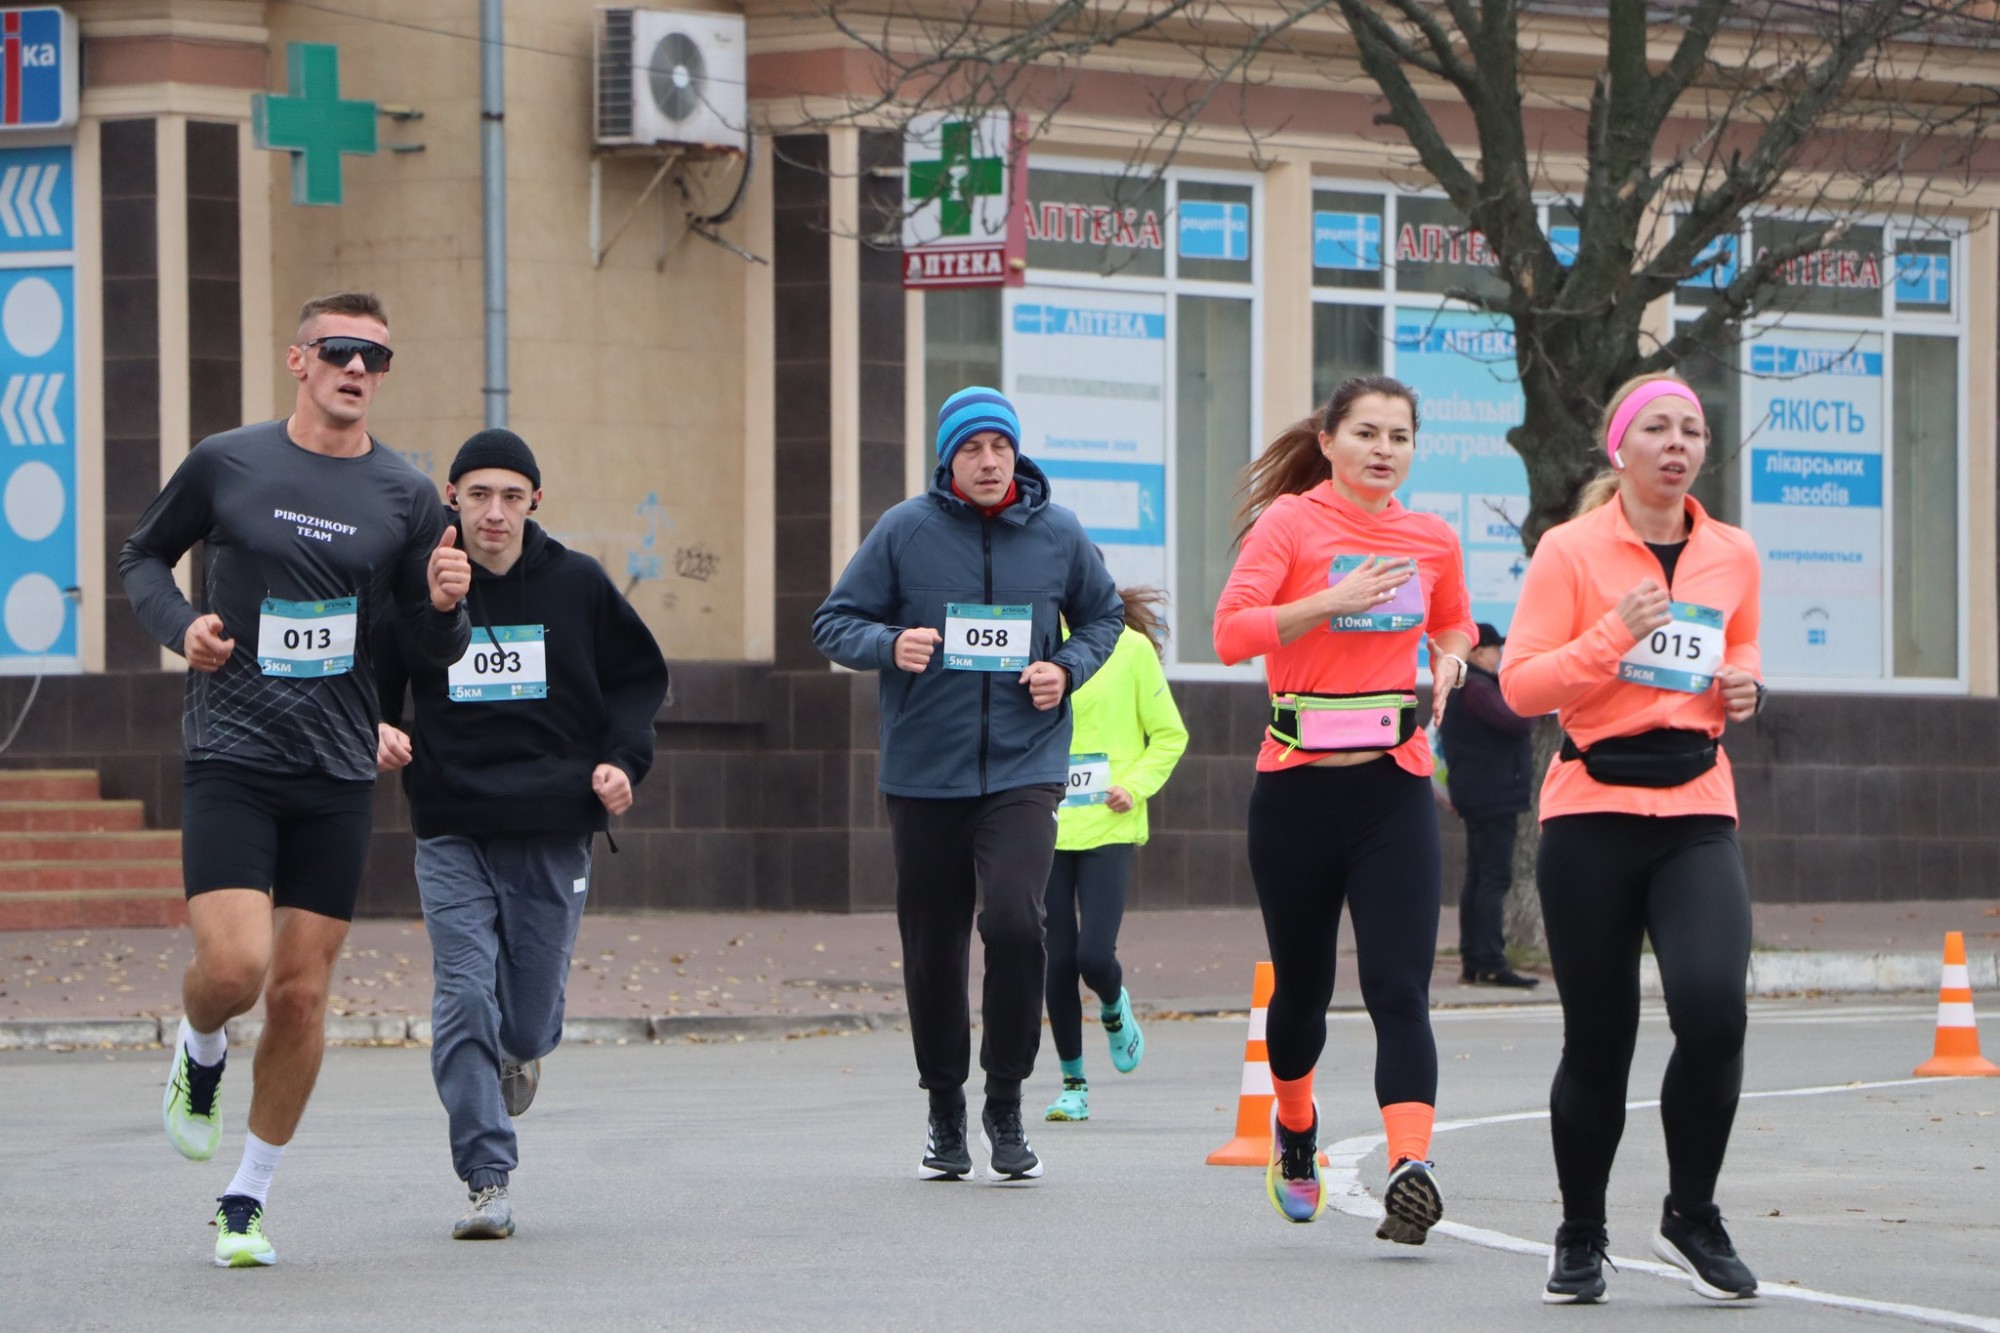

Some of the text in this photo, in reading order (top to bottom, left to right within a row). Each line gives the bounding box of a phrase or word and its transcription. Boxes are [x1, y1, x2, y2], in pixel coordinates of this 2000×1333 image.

[1024, 200, 1163, 250] АПТЕКА
[906, 251, 1003, 279] АПТЕКА
[1063, 310, 1148, 339] АПТЕКА
[1793, 350, 1867, 375] АПТЕКА
[1414, 389, 1521, 424] оціальні
[1767, 396, 1866, 434] ЯКІСТЬ
[1416, 431, 1520, 463] рограм
[1765, 452, 1865, 478] лікарських
[1781, 482, 1850, 505] засобів
[273, 508, 358, 536] PIROZHKOFF
[296, 525, 333, 542] TEAM
[1768, 550, 1863, 564] контролюється
[283, 628, 332, 650] 013
[966, 628, 1009, 647] 058
[1650, 631, 1702, 660] 015
[473, 651, 522, 674] 093
[1065, 771, 1092, 788] 07
